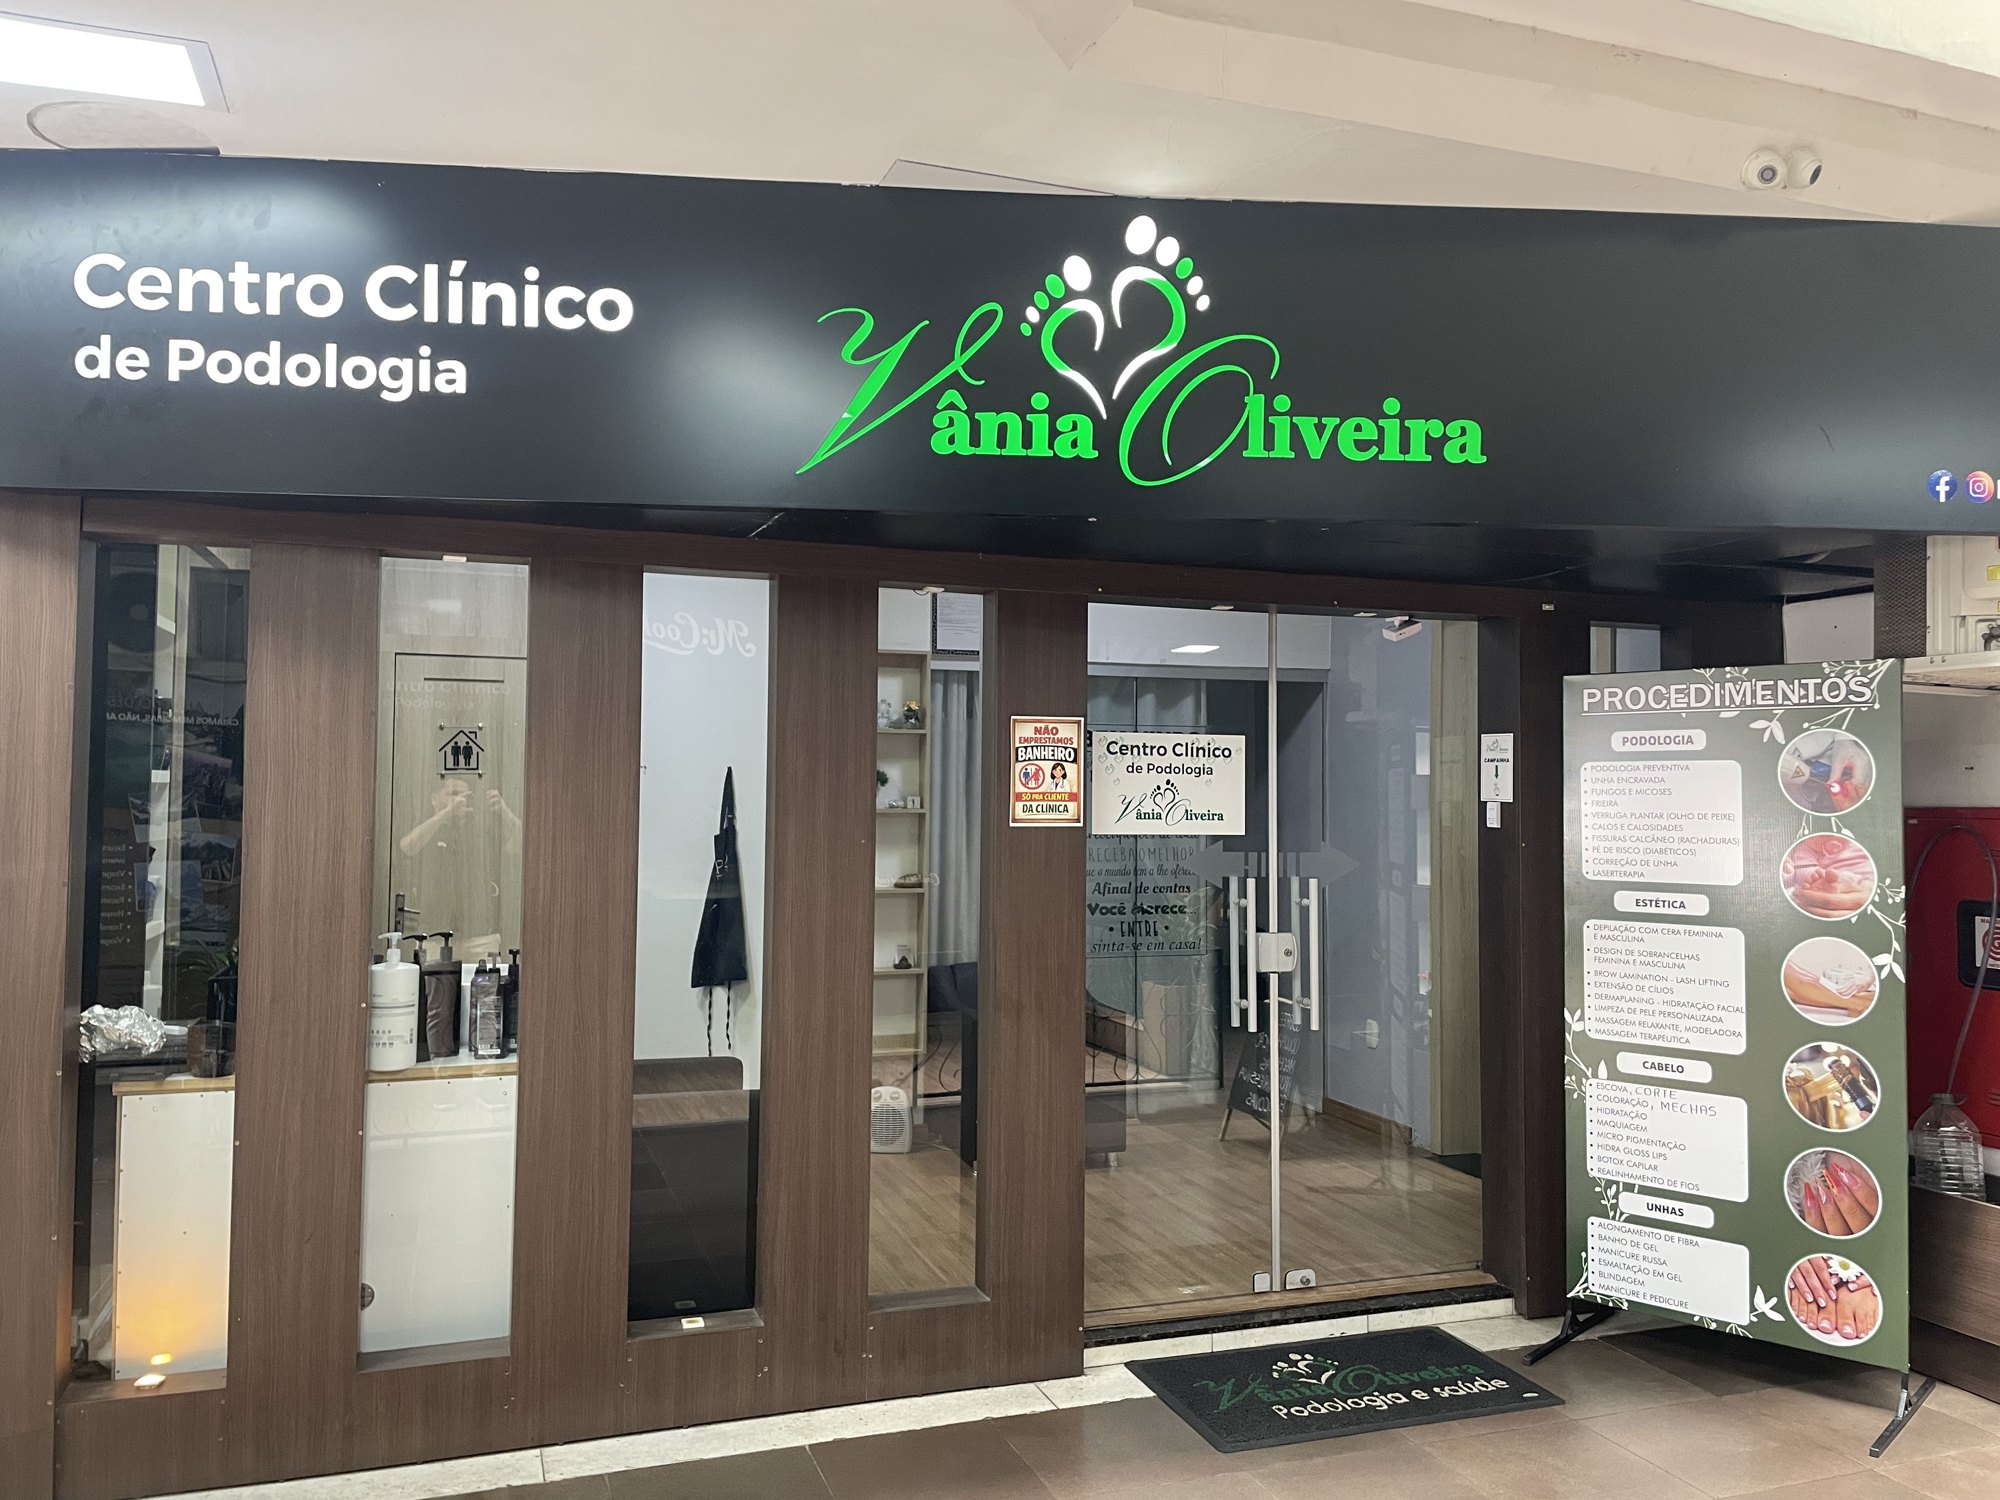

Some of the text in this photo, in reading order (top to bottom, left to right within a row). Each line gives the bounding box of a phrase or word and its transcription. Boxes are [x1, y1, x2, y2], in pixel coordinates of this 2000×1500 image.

[73, 252, 634, 332] Centro Clínico
[74, 334, 467, 402] de Podologia
[796, 302, 1487, 486] Vânia Oliveira
[1582, 675, 1872, 712] PROCEDIMENTOS
[1034, 725, 1059, 735] NÃO
[1018, 736, 1074, 745] EMPRESTAMOS
[1621, 734, 1694, 747] PODOLOGIA
[1017, 746, 1075, 761] BANHEIRO
[1106, 740, 1232, 758] Centro Clínico
[1126, 762, 1213, 778] de Podologia
[1590, 764, 1690, 772] PODOLOGIA PREVENTIVA
[1590, 776, 1666, 784] UNHA ENCRAVADA
[1021, 792, 1030, 800] SÓ
[1591, 788, 1626, 796] FUNGOS
[1634, 788, 1672, 796] MICOSES
[1022, 802, 1070, 813] DA CLÍNICA
[1114, 793, 1224, 827] Vânia Oliveira
[1590, 812, 1628, 820] VERRUGA
[1629, 812, 1664, 820] PLANTAR
[1591, 823, 1619, 831] CALOS
[1591, 835, 1627, 843] FISSURAS
[1603, 846, 1614, 854] DE
[1615, 847, 1641, 855] RISCO
[1639, 859, 1650, 867] DE
[1652, 859, 1678, 868] UNHA
[1592, 870, 1645, 878] LASERTERAPIA
[1092, 882, 1132, 896] Afinal
[1152, 884, 1191, 894] contas
[1087, 902, 1126, 916] Você
[1635, 897, 1686, 910] ESTÉTICA
[1120, 920, 1159, 937] ENTRE
[1593, 924, 1723, 938] DEPILAÇÃO COM CERA FEMININA
[1147, 942, 1165, 951] em
[1169, 938, 1202, 951] casa!
[1599, 933, 1645, 943] MASCULINA
[1593, 947, 1700, 961] DESIGN DE SOBRANCELHAS
[1593, 956, 1631, 966] FEMININA
[1638, 959, 1686, 970] MASCULINA
[1594, 970, 1617, 979] BROW
[1619, 971, 1669, 983] LAMINATION
[1675, 976, 1696, 985] LASH
[1698, 978, 1730, 988] LIFTING
[1593, 981, 1674, 995] EXTENSÃO DE CÍLIOS
[1594, 993, 1655, 1005] DERMAPLANING
[1662, 998, 1715, 1011] HIDRATAÇÃO
[1716, 1003, 1745, 1013] FACIAL
[1594, 1004, 1724, 1023] LIMPEZA DE PELE PERSONALIZADA
[1594, 1016, 1743, 1038] MASSAGEM RELAXANTE, MODELADORA
[1594, 1028, 1691, 1045] MASSAGEM TERAPEUTICA
[1642, 1060, 1684, 1074] CABELO
[1635, 1086, 1678, 1100] CORTE
[1596, 1106, 1647, 1120] HIDRATAÇÃO
[1660, 1101, 1717, 1117] MECHAS
[1596, 1119, 1648, 1132] MAQUIAGEM
[1596, 1132, 1686, 1150] MICRO PIGMENTAÇÃO
[1597, 1143, 1668, 1160] HIDRA GLOSS LIPS
[1597, 1156, 1658, 1172] BOTOX CAPILAR
[1597, 1168, 1700, 1191] REALINHAMENTO DE FIOS
[1646, 1202, 1684, 1217] UNHAS
[1597, 1223, 1700, 1247] ALONGAMENTO DE FIBRA
[1597, 1235, 1658, 1251] BANHO DE GEL
[1597, 1247, 1667, 1265] MANICURE RUSSA
[1598, 1259, 1682, 1282] ESMALTAÇÃO EM GEL
[1598, 1271, 1645, 1286] BLINDAGEM
[1598, 1284, 1640, 1299] MANICURE
[1649, 1294, 1688, 1308] PEDICURE
[1271, 1374, 1510, 1419] Podologia e saúde
